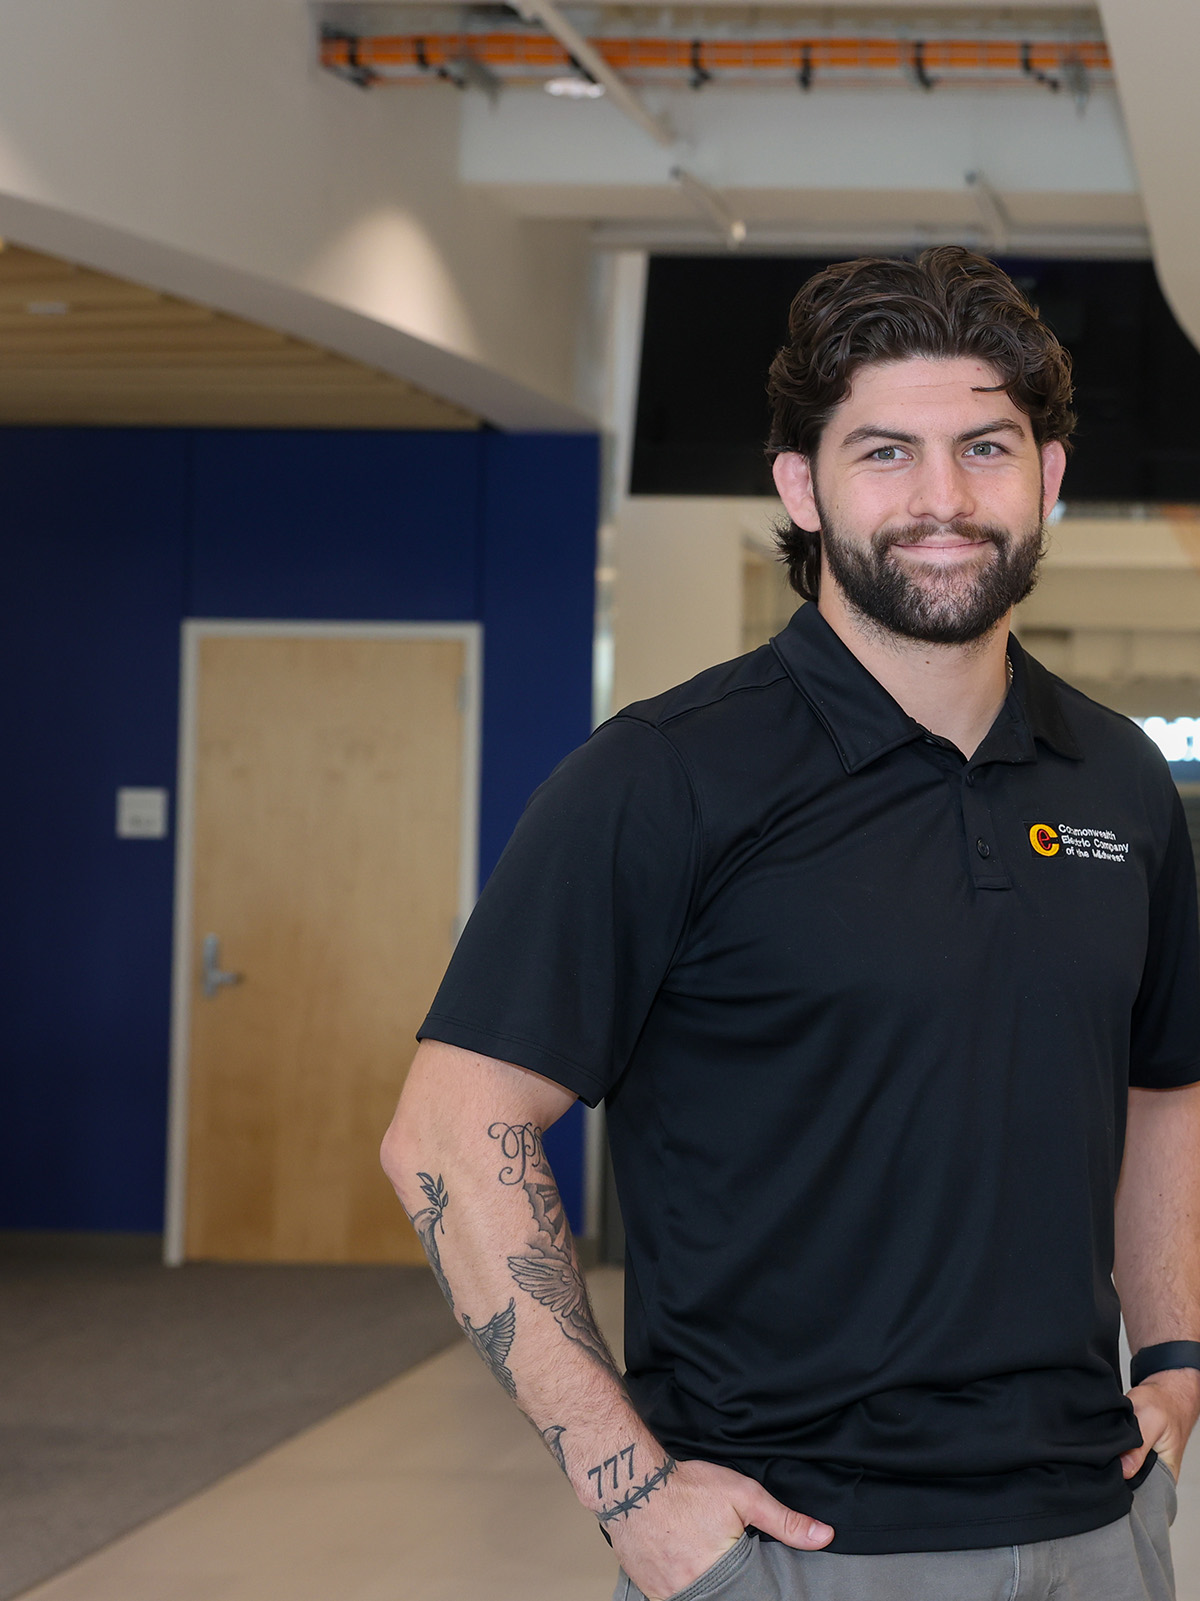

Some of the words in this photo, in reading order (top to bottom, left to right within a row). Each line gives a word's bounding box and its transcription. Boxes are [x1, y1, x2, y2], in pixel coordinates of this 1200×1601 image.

[1058, 824, 1116, 840] Commonwealth
[1061, 834, 1091, 848] Electric
[1093, 838, 1129, 853] Company
[1065, 846, 1075, 855] of
[1076, 848, 1090, 858] the
[1092, 849, 1126, 862] Midwest
[587, 1443, 636, 1499] 777
